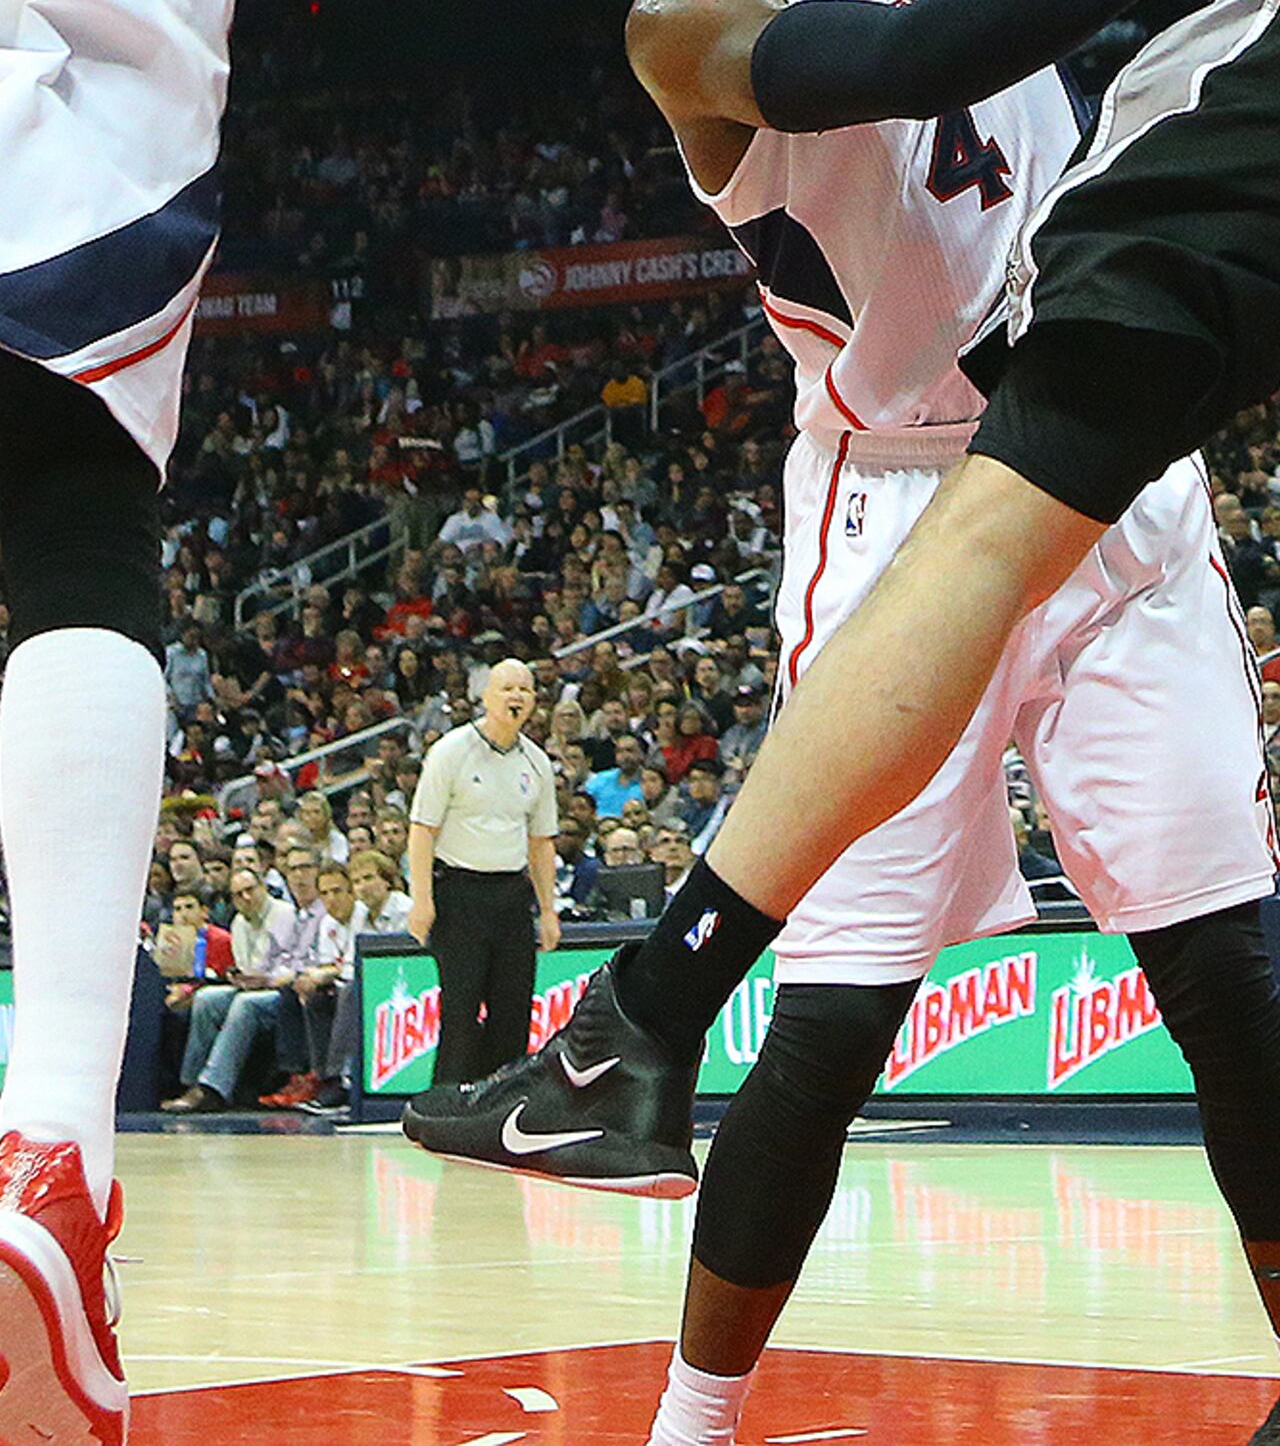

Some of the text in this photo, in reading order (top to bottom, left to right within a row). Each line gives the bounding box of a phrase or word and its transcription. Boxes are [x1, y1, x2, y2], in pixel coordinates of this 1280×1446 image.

[925, 104, 1014, 212] 4
[562, 258, 630, 292] JOHNNY
[634, 253, 697, 285] CASH'S
[371, 985, 442, 1091] LIBM
[1047, 966, 1163, 1091] LIBM
